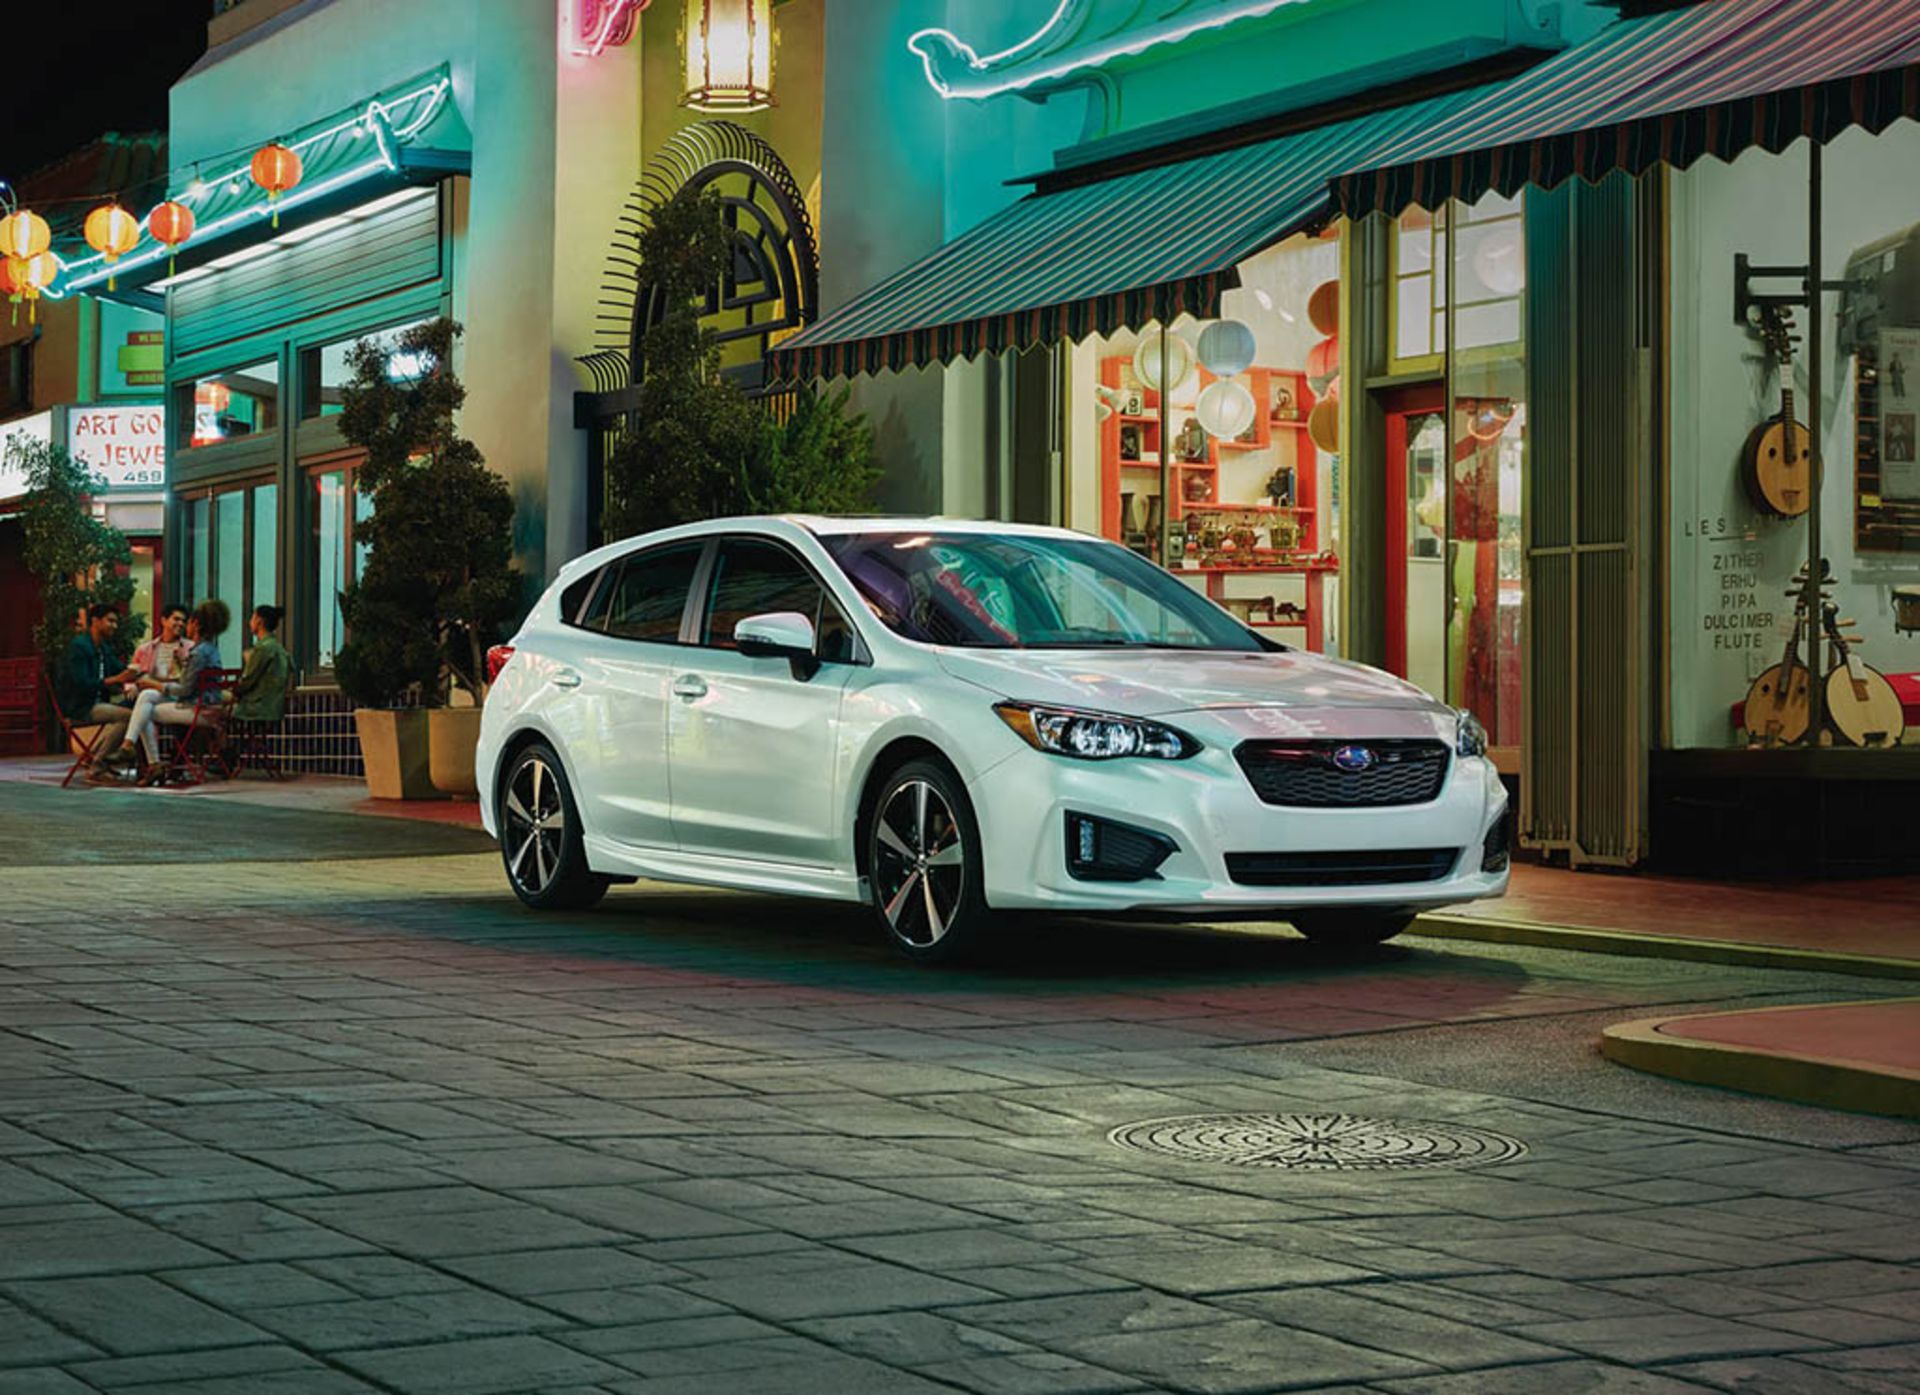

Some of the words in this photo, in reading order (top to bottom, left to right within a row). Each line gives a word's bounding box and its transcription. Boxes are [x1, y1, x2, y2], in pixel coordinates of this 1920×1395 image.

[76, 414, 121, 436] ART
[99, 443, 165, 466] JEWE
[1713, 552, 1764, 570] ZITHER
[1721, 574, 1757, 590] ERHU
[1721, 593, 1757, 609] PIPA
[1704, 613, 1773, 630] DULCIMER
[1714, 633, 1763, 650] FLUTE
